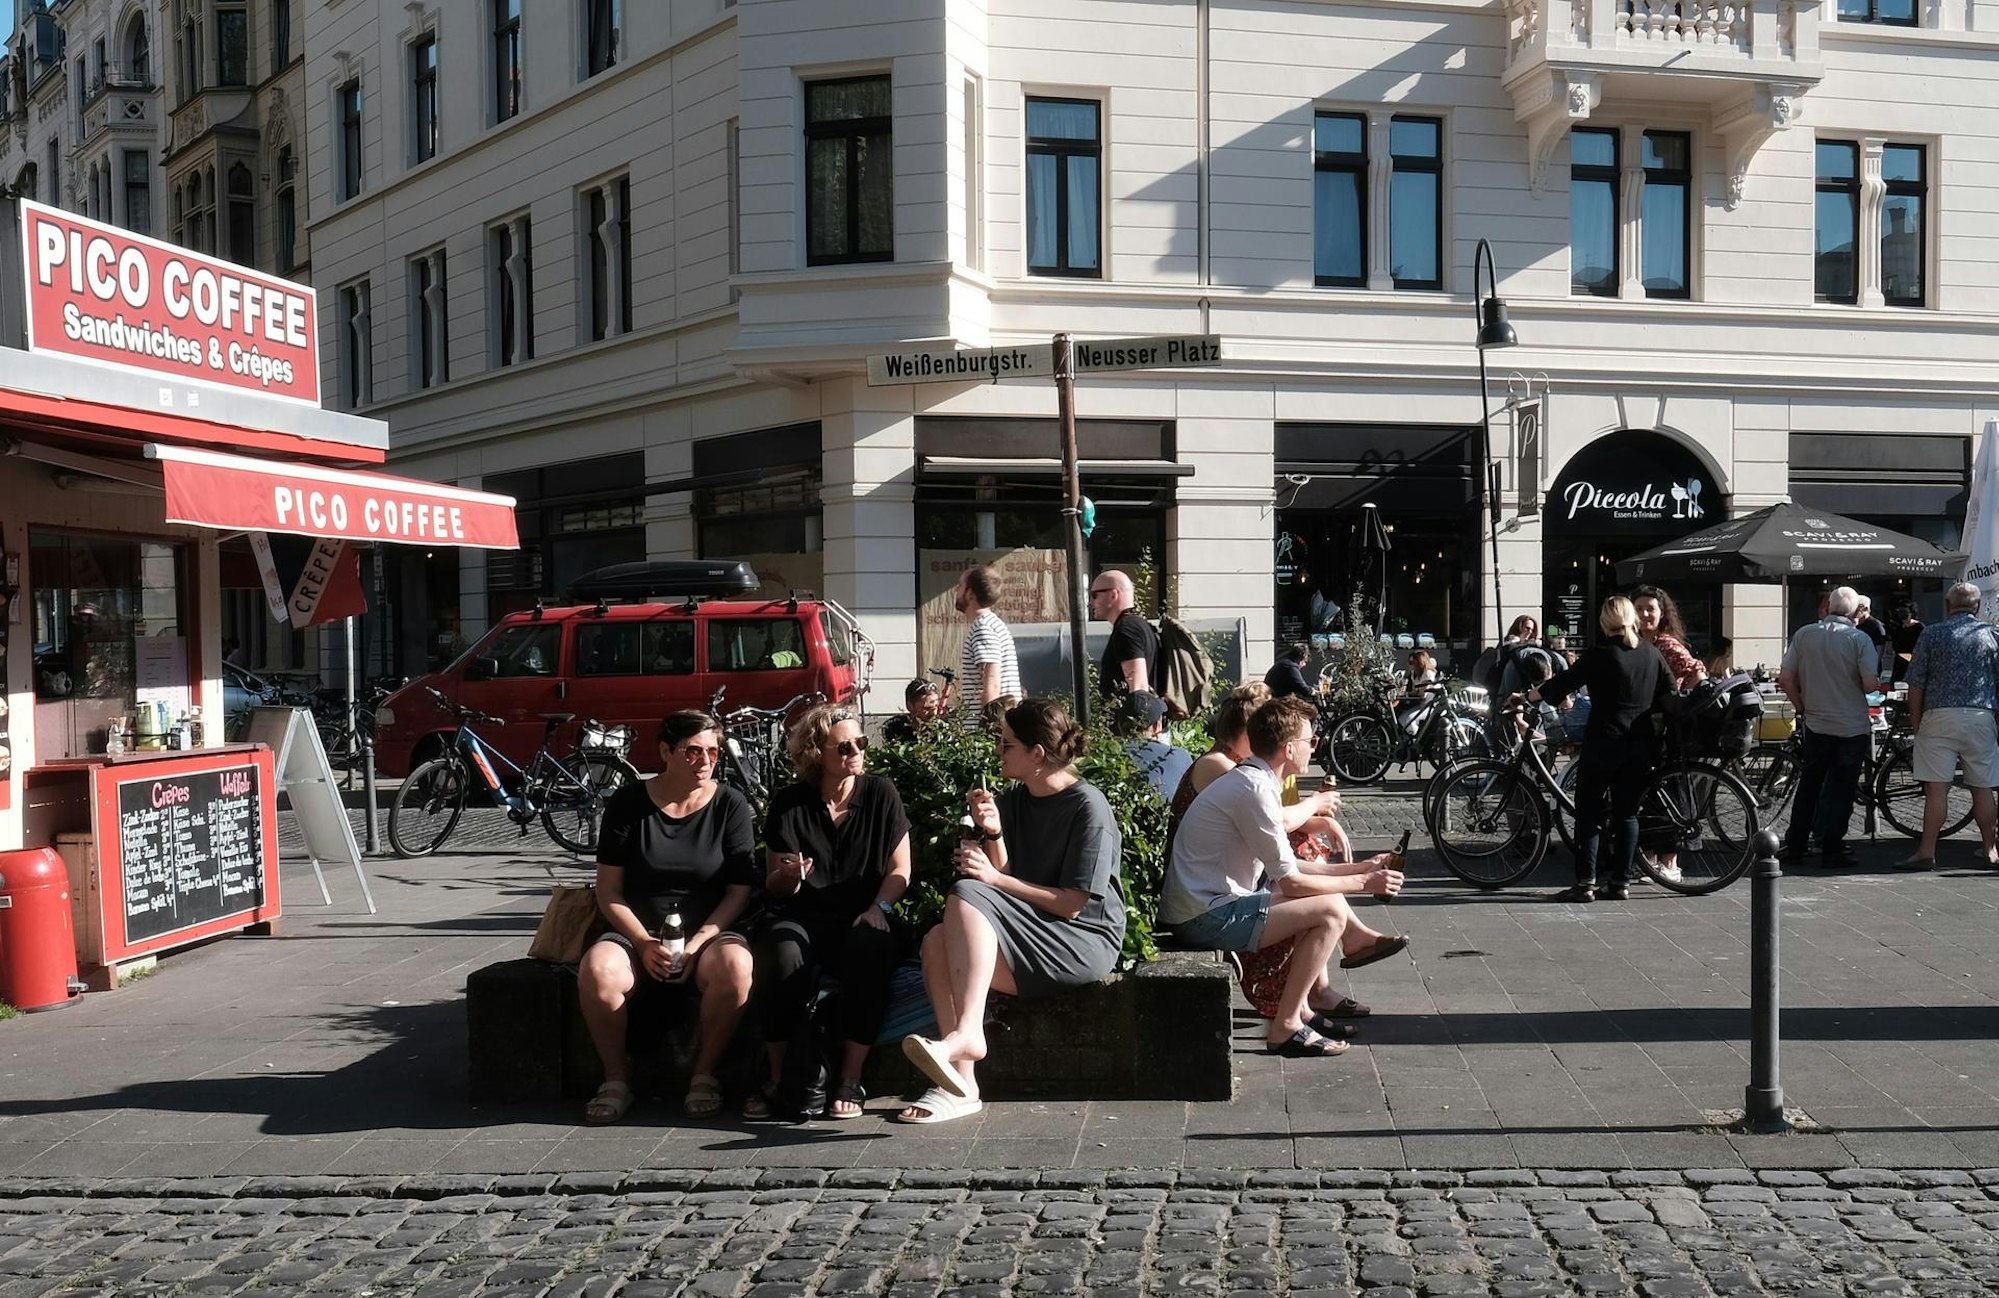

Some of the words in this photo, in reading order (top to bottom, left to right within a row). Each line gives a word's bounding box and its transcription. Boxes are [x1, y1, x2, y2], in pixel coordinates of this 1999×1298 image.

[36, 218, 150, 308] PICO
[163, 258, 307, 348] COFFEE
[64, 302, 203, 366] Sandwiches
[207, 336, 225, 369] &
[228, 340, 294, 387] Crêpes
[1077, 344, 1158, 367] Neusser
[1167, 339, 1220, 363] Platz
[885, 351, 1033, 379] Weißenburgstr.
[275, 486, 348, 531] PICO
[364, 497, 465, 539] COFFEE
[1563, 480, 1668, 521] Piccola
[1613, 510, 1632, 519] Essen
[1632, 510, 1638, 519] &
[1638, 510, 1662, 519] Trinken
[1952, 559, 1999, 585] mbach
[152, 782, 190, 808] Crêpes
